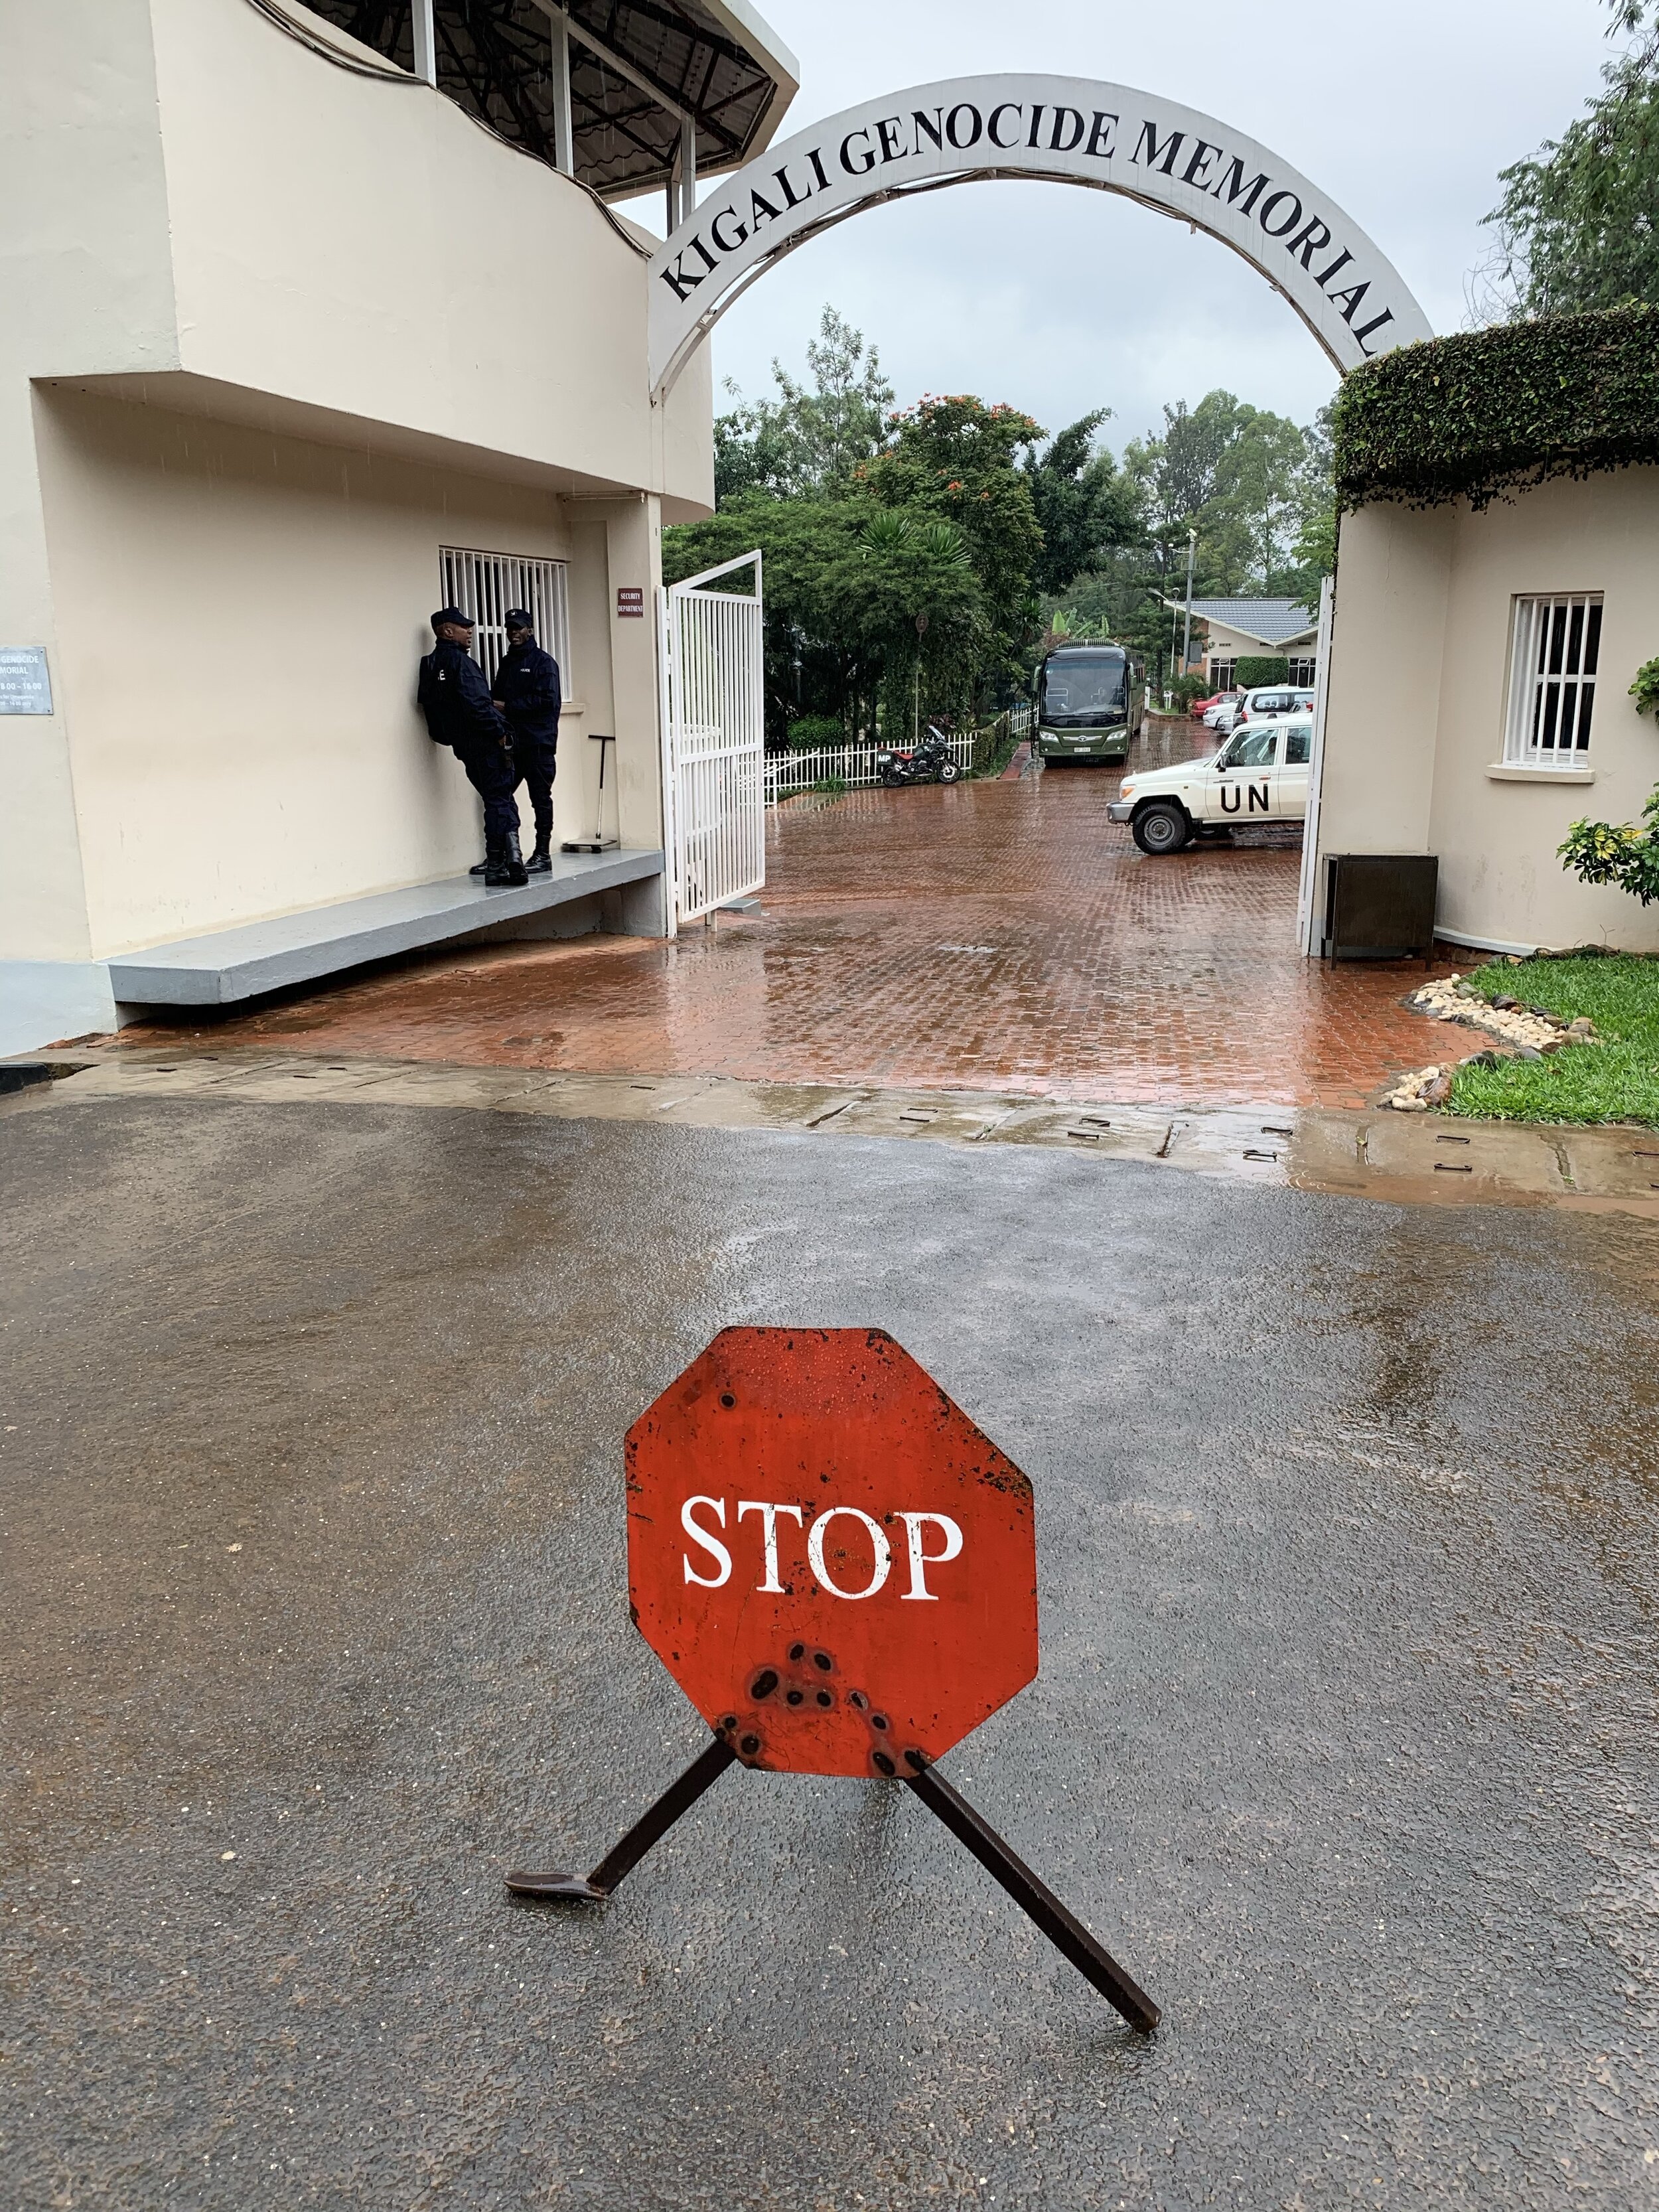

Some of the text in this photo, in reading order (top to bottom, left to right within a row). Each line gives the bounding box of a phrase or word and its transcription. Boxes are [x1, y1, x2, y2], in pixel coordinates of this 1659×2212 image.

[659, 103, 1396, 358] KIGALI GENOCIDE MEMORIAL
[1, 655, 40, 664] GENOCIDE
[1221, 784, 1269, 813] UN
[681, 1495, 964, 1601] STOP
